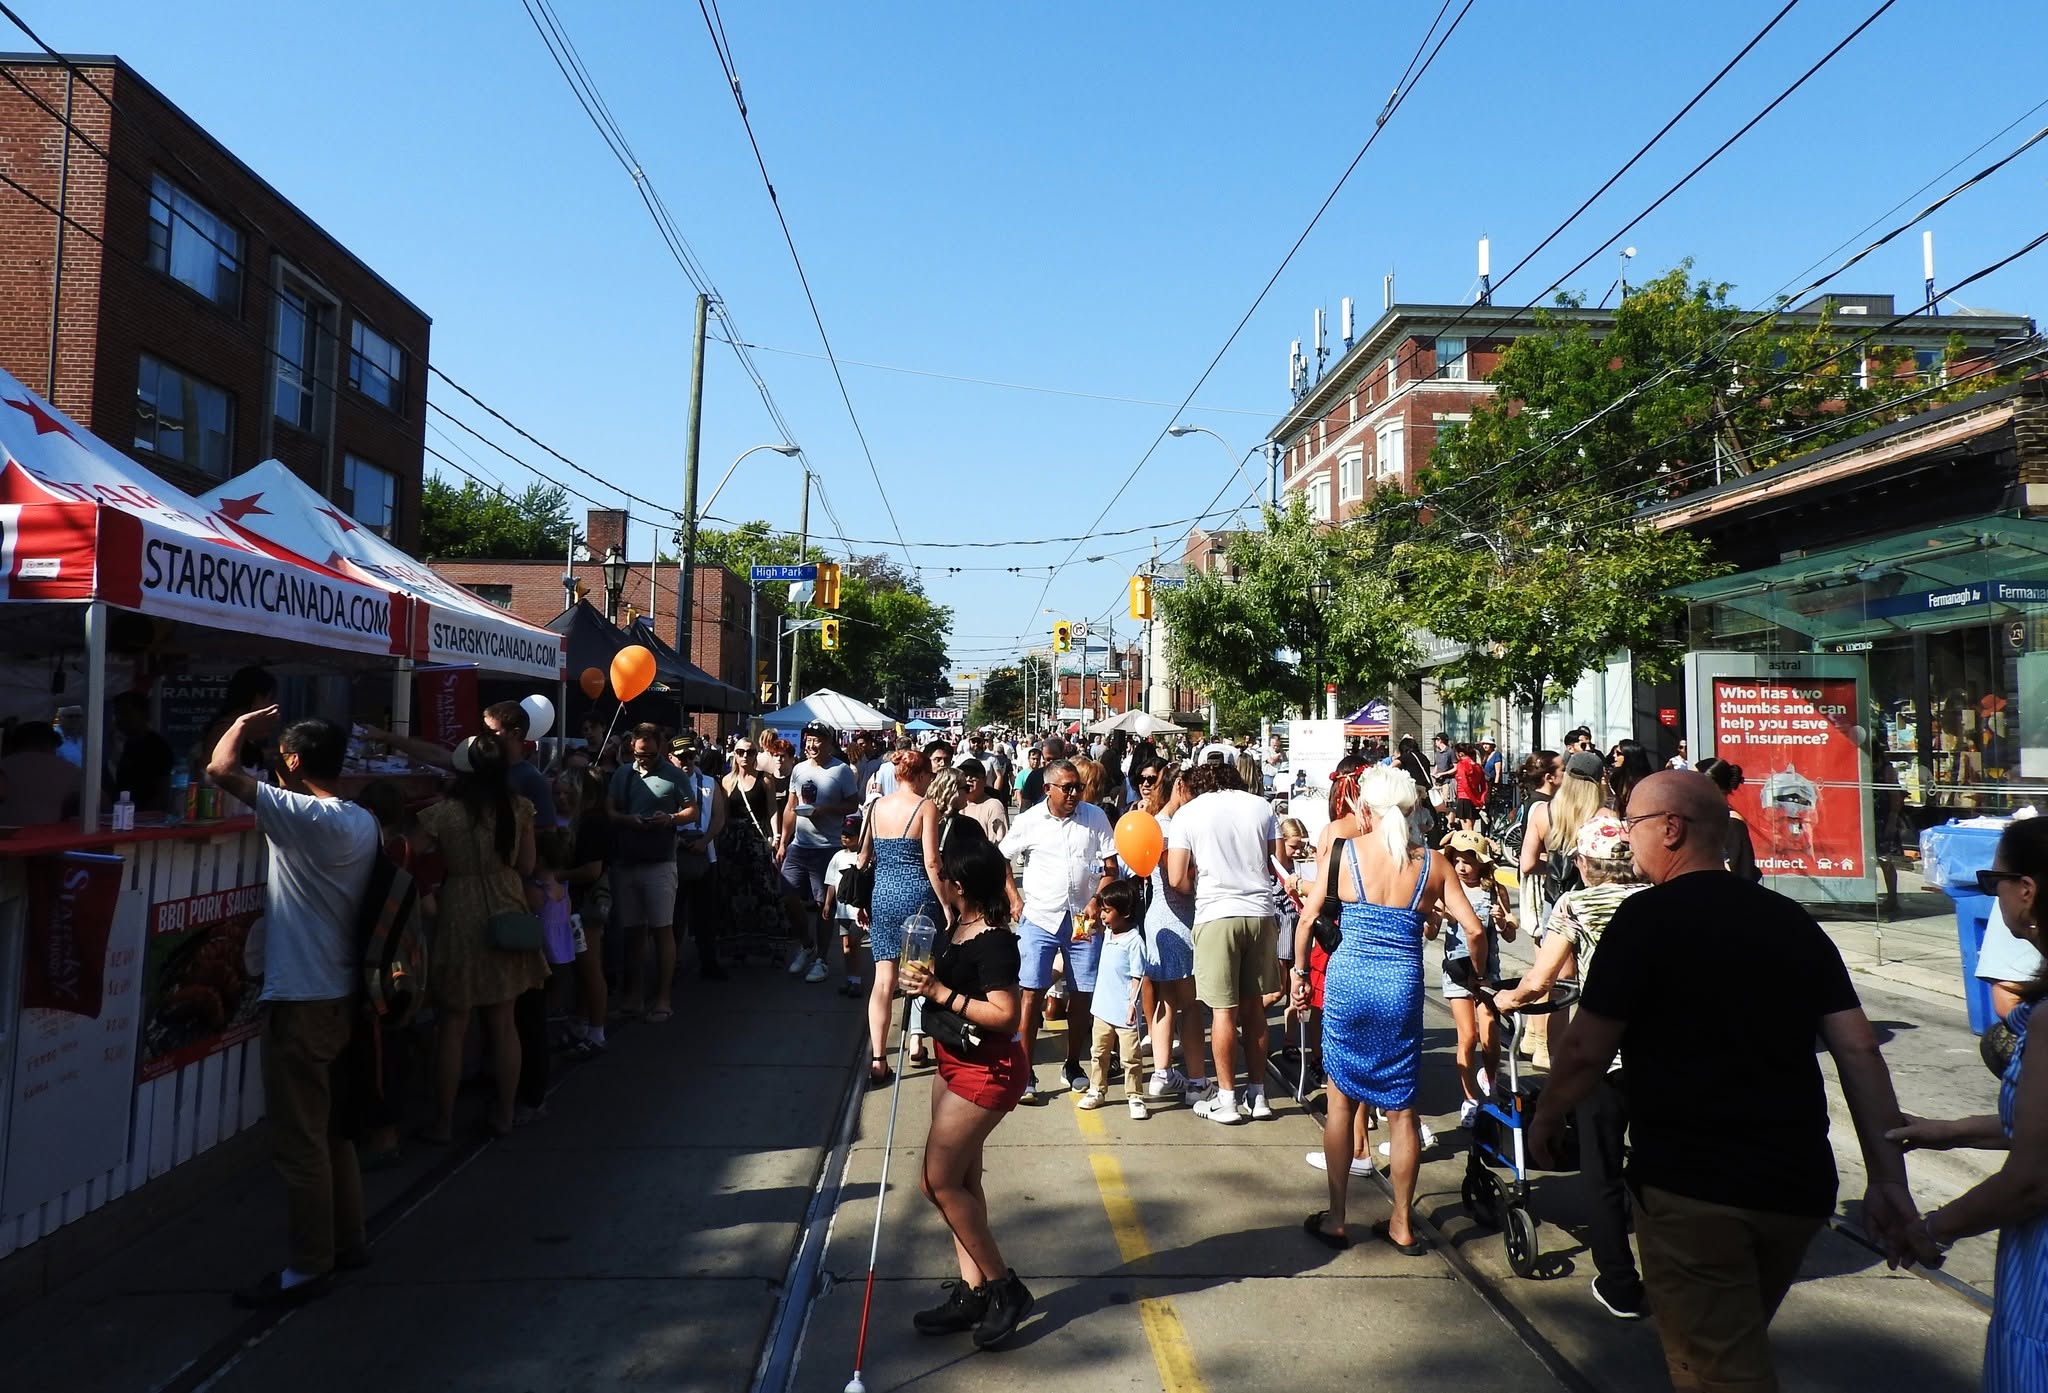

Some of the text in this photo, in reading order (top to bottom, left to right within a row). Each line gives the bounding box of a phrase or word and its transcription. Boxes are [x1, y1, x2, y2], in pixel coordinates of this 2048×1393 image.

[756, 567, 777, 578] High
[782, 567, 804, 576] Park
[144, 538, 389, 636] STARSKYCANADA.COM
[1999, 584, 2048, 599] Fermana
[1928, 587, 1981, 608] Fermanagh Av
[433, 622, 557, 668] STARSKYCANADA.COM
[1768, 659, 1801, 670] astral
[1720, 687, 1823, 700] Who has two
[913, 710, 958, 718] PIEROGI
[1720, 702, 1847, 715] thumbs and can
[1720, 717, 1829, 731] help you save
[1721, 732, 1829, 745] on insurance?
[158, 885, 267, 934] BBQ PORK SAUSA
